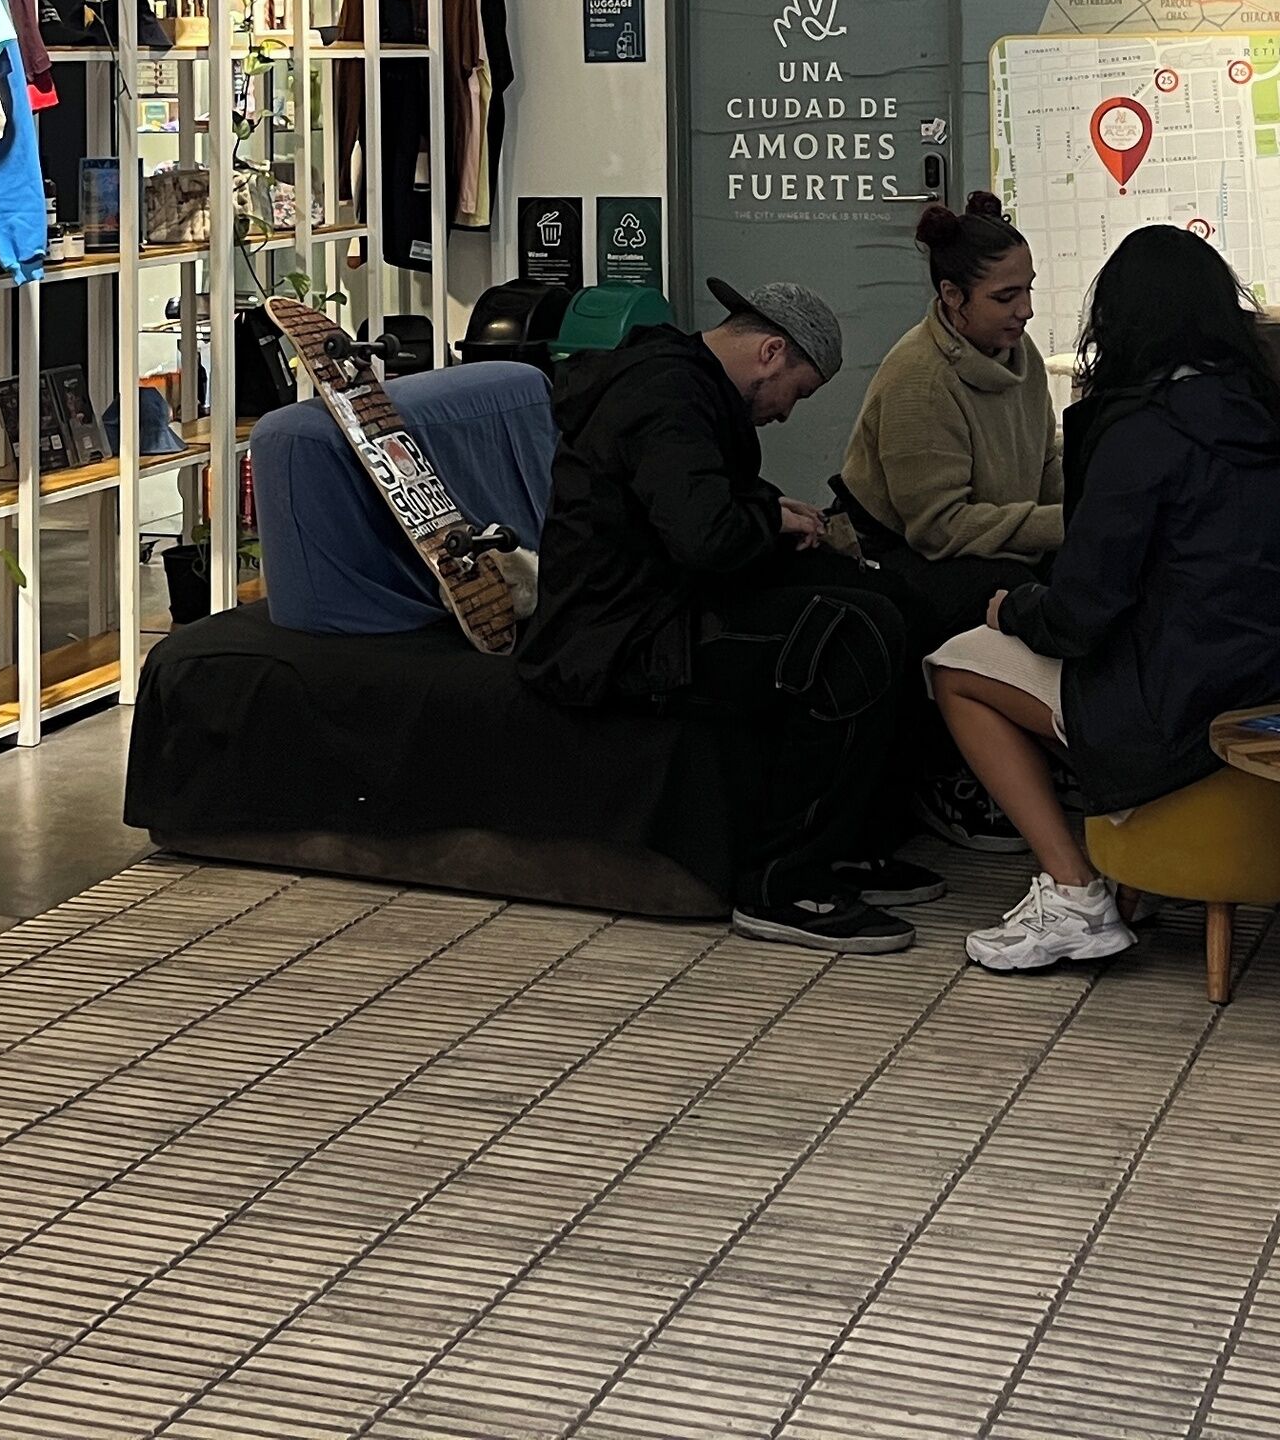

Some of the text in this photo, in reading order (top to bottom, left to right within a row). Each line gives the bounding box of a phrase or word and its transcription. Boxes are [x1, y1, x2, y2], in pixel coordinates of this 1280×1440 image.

[589, 0, 632, 9] LUGGAGE
[778, 62, 844, 84] UNA
[726, 97, 898, 119] CIUDAD DE
[729, 133, 896, 161] AMORES
[728, 174, 898, 201] FUERTES
[735, 211, 752, 220] THE
[754, 211, 774, 221] CITY
[777, 211, 811, 220] WHERE
[813, 211, 838, 220] LOVE
[852, 212, 892, 221] STRONG
